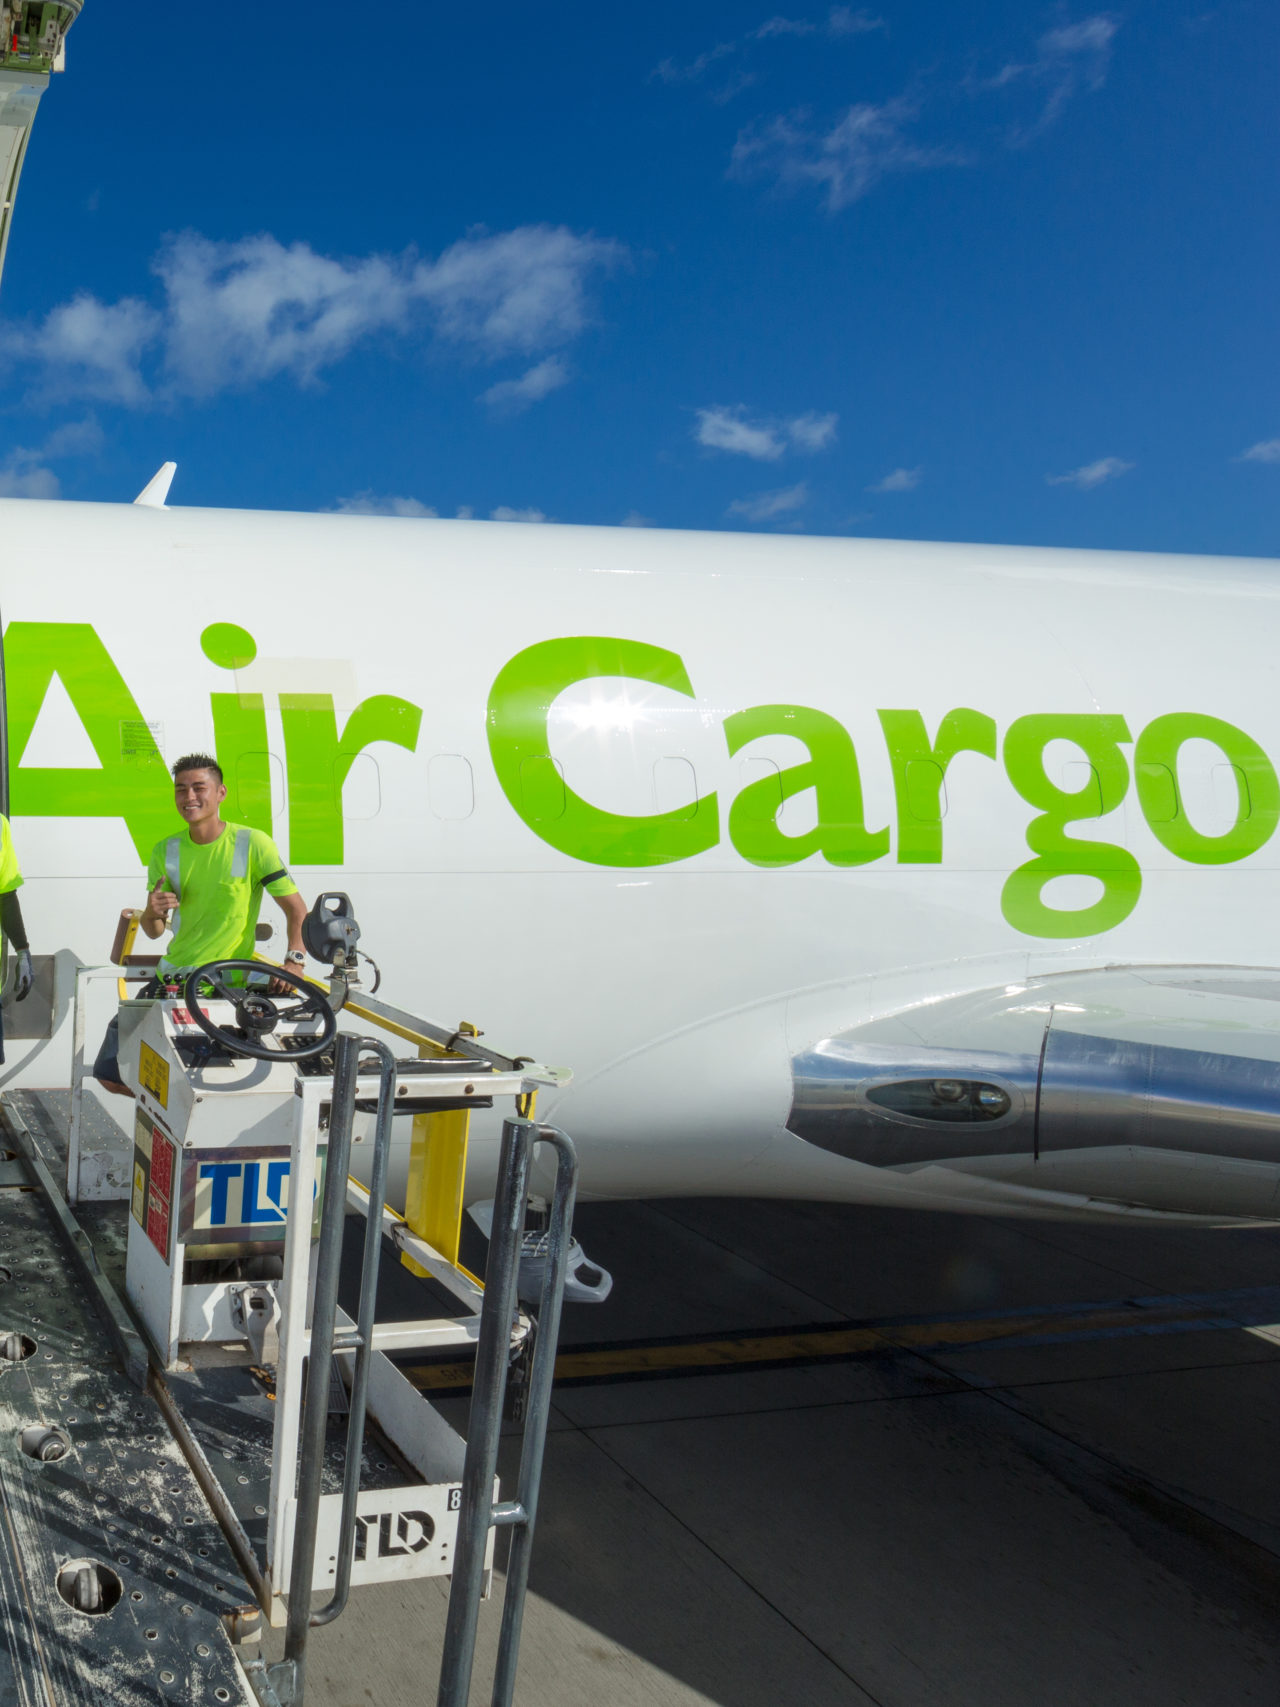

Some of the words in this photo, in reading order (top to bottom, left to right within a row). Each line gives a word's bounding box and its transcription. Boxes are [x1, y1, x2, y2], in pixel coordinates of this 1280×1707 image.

[3, 621, 424, 867] Air
[487, 635, 1280, 939] Cargo
[354, 1510, 436, 1562] TLD
